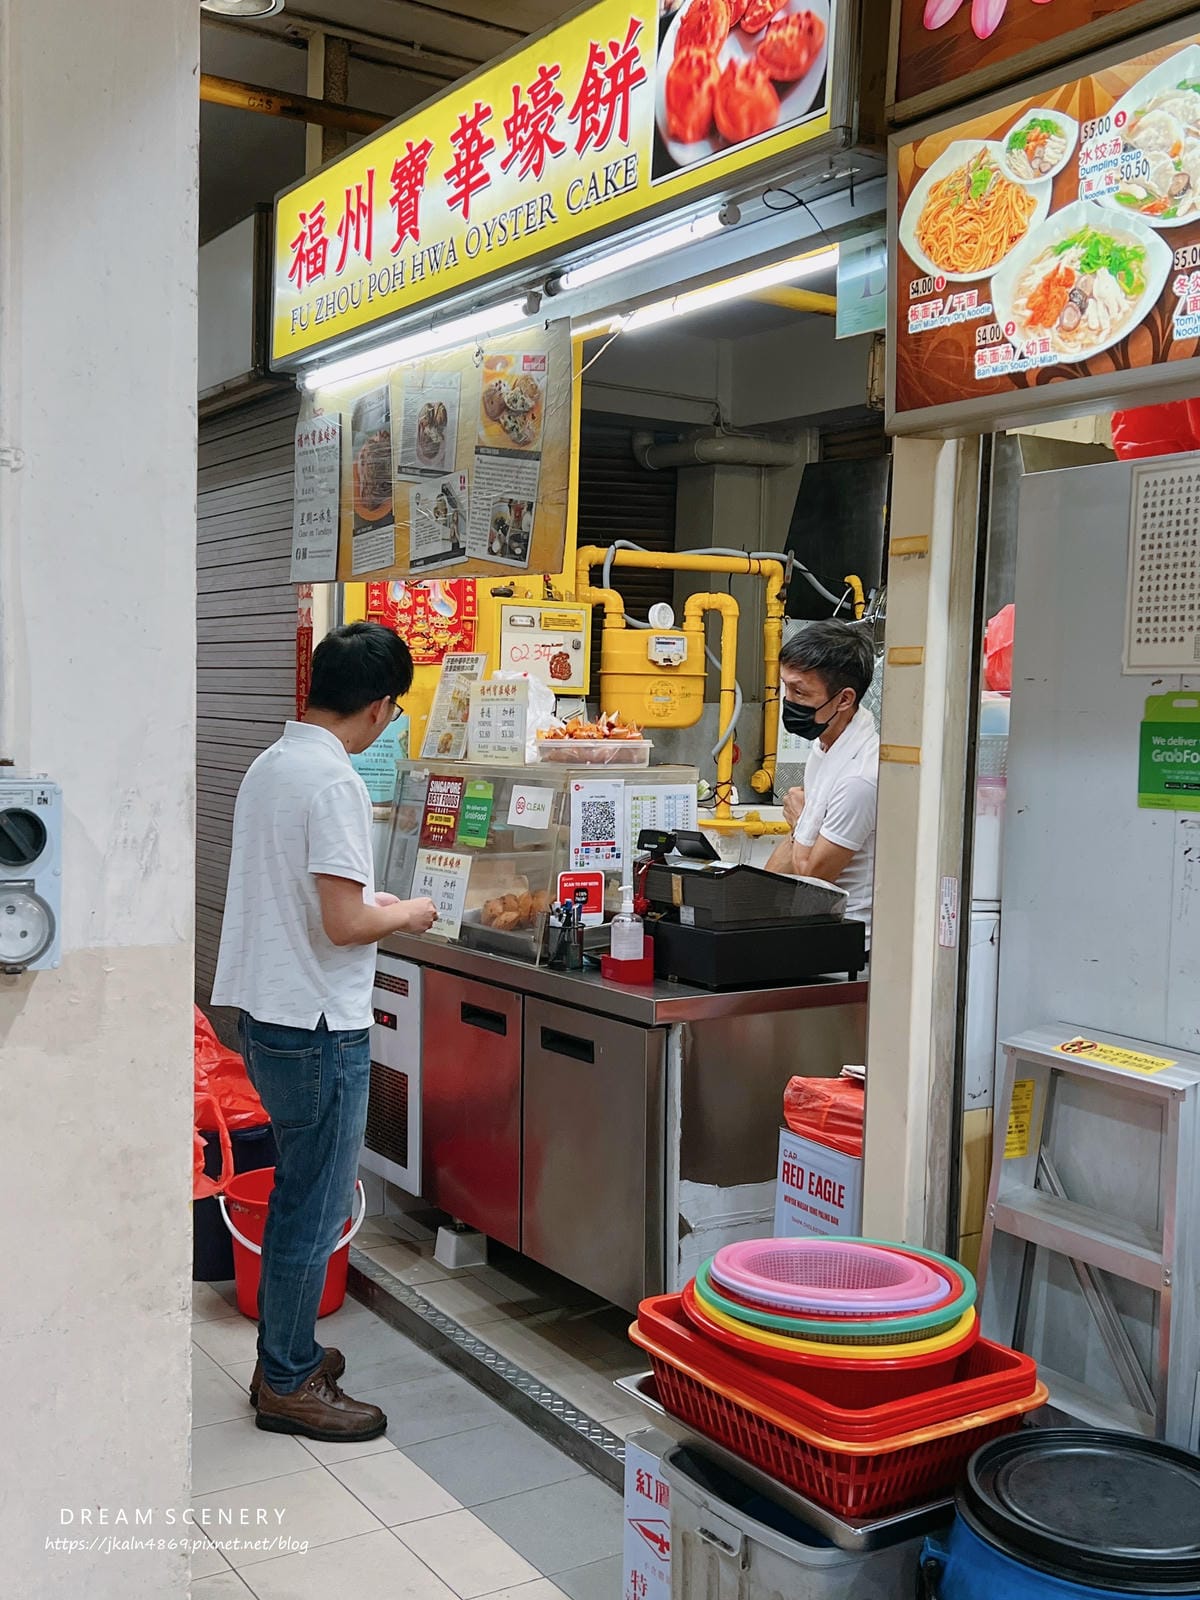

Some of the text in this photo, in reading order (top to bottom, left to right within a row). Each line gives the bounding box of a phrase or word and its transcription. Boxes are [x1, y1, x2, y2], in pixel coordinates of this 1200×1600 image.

[247, 96, 274, 110] GAS
[1083, 116, 1111, 139] $5.00
[287, 17, 647, 290] 福州寶華蠔餅
[1080, 138, 1121, 165] 水饺汤
[1080, 151, 1142, 176] Dumpling Soup
[290, 153, 639, 336] FU ZHOU POH HWA OYSTER CAKE
[1175, 246, 1200, 269] $5.0
[911, 277, 933, 296] $4.00
[910, 323, 922, 332] Ban
[923, 319, 938, 329] Mian
[967, 305, 991, 316] Noodle
[1175, 316, 1194, 327] Tom
[977, 324, 1001, 343] $4.00
[977, 367, 990, 377] Ban
[992, 363, 1008, 374] Mian
[1152, 736, 1197, 746] We deliver
[430, 780, 461, 794] SINGAPORE
[428, 793, 458, 806] BEST FOODS
[527, 802, 546, 812] CLEAN
[464, 811, 486, 821] GrabFood
[783, 1148, 798, 1160] CAP
[782, 1160, 846, 1209] RED EAGLE
